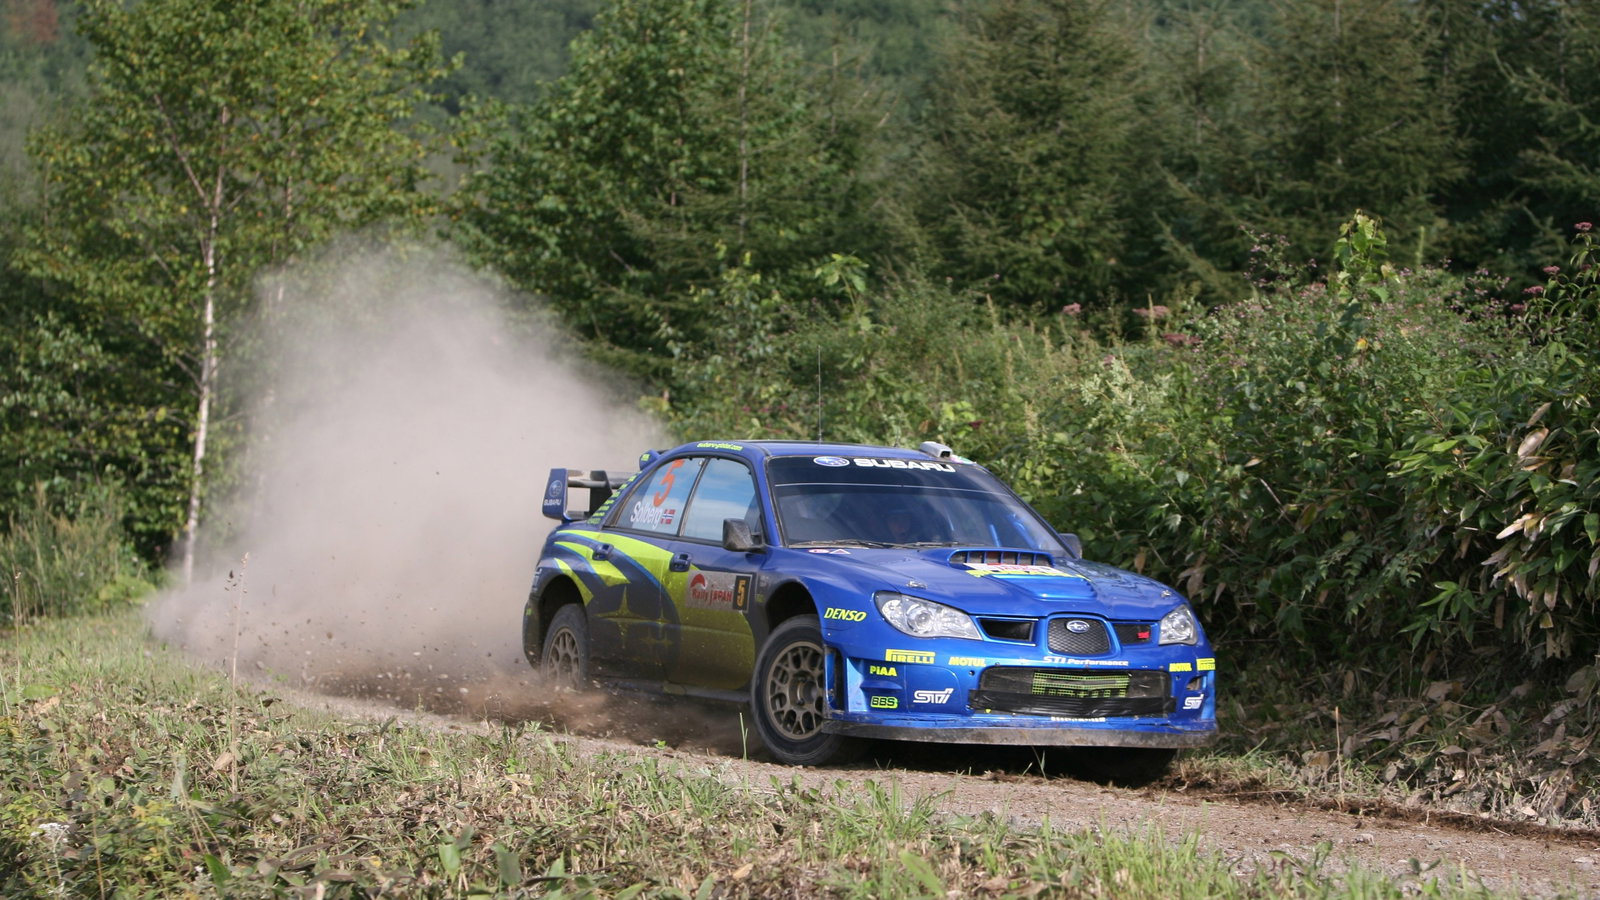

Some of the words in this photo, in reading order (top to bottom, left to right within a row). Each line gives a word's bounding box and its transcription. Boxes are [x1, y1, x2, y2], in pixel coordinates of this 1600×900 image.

[853, 457, 956, 473] SUBARU
[653, 459, 685, 507] 5
[543, 498, 562, 506] SUBARU
[630, 501, 661, 530] Solberg
[736, 579, 747, 607] 5
[824, 607, 867, 622] DENSO
[885, 648, 936, 664] PIRELLI
[948, 656, 987, 667] MOTUL
[1067, 658, 1129, 667] Performance
[869, 665, 897, 677] PIAA
[870, 696, 898, 708] BBS
